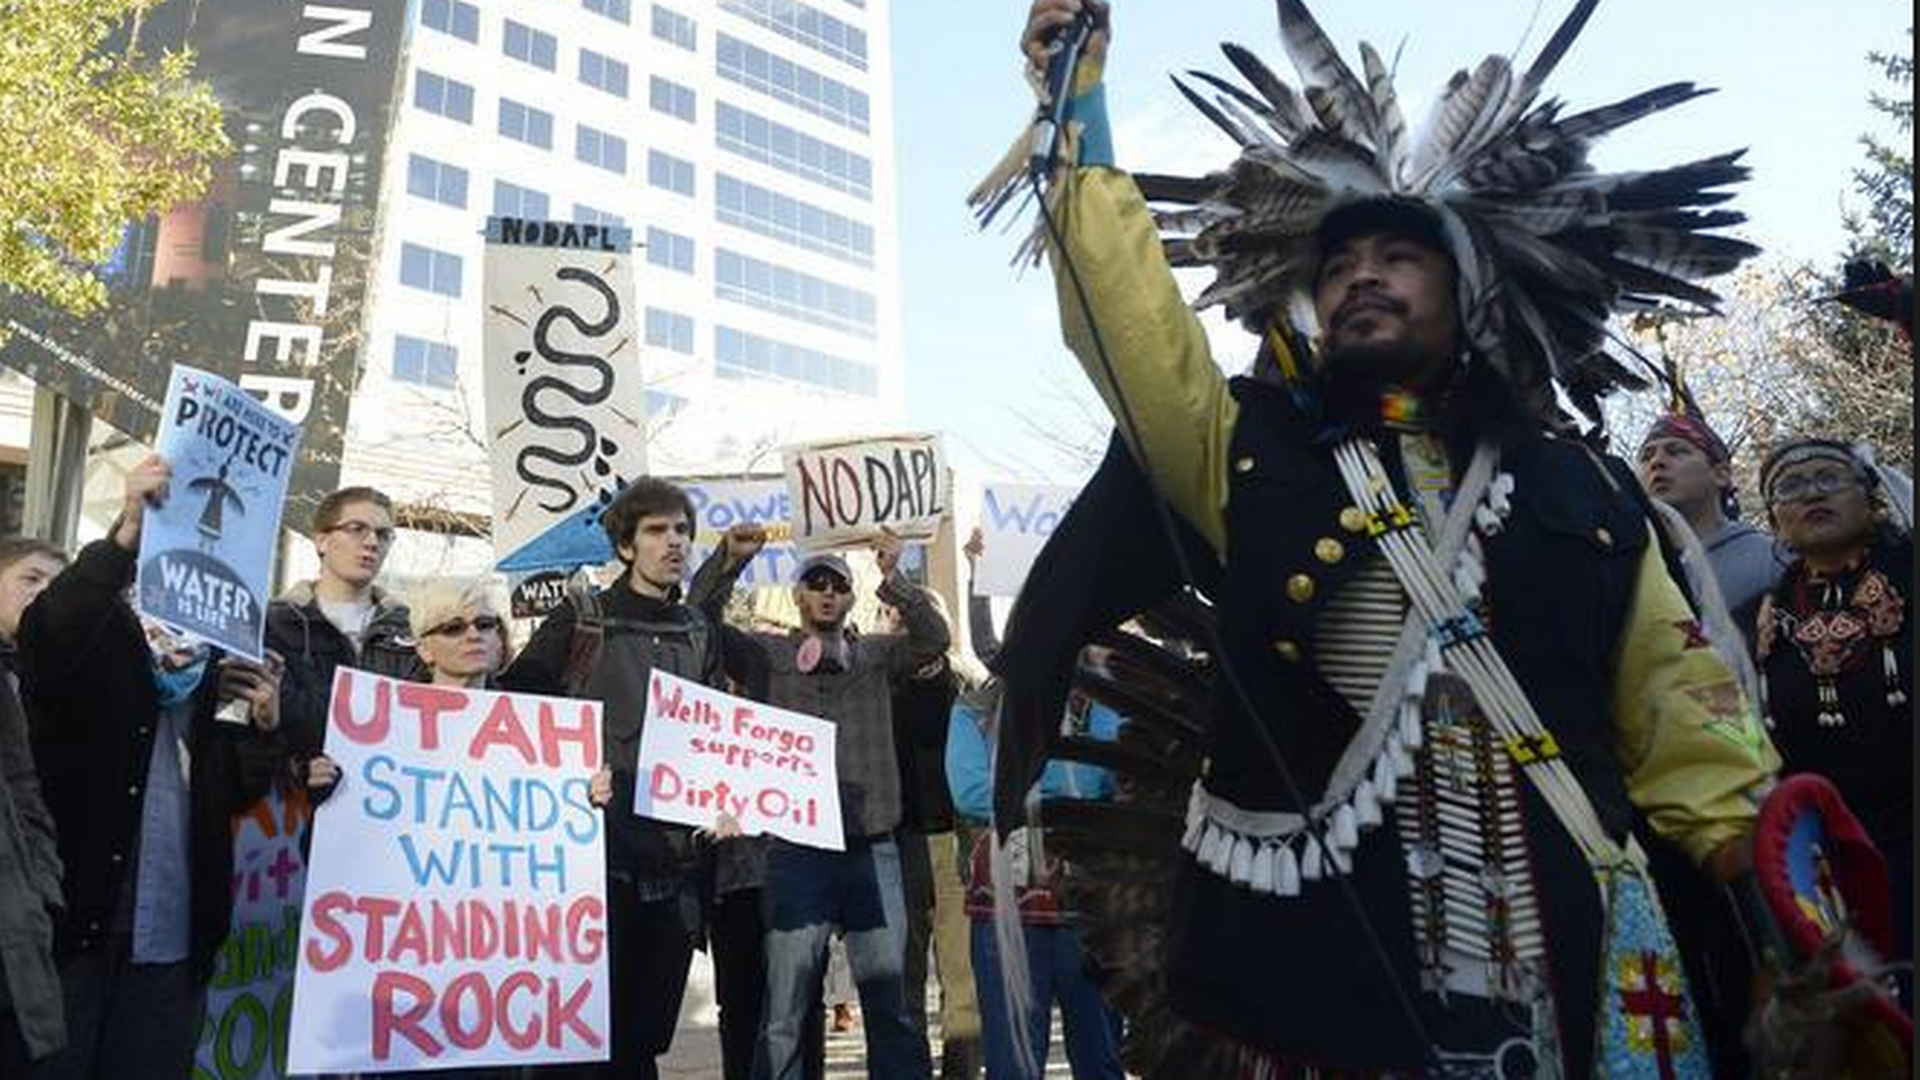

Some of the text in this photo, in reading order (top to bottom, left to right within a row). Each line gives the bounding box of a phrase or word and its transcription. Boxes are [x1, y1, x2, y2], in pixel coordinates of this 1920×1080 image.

[239, 5, 372, 424] N CENTER
[176, 397, 289, 478] PROTECT
[797, 446, 943, 537] NO DAPL
[160, 555, 251, 621] WATER
[333, 671, 599, 768] UTAH
[362, 755, 600, 844] STANDS
[652, 762, 817, 828] Dirty Oil
[399, 834, 566, 894] WITH
[306, 891, 605, 973] STANDING
[371, 971, 604, 1061] ROCK
